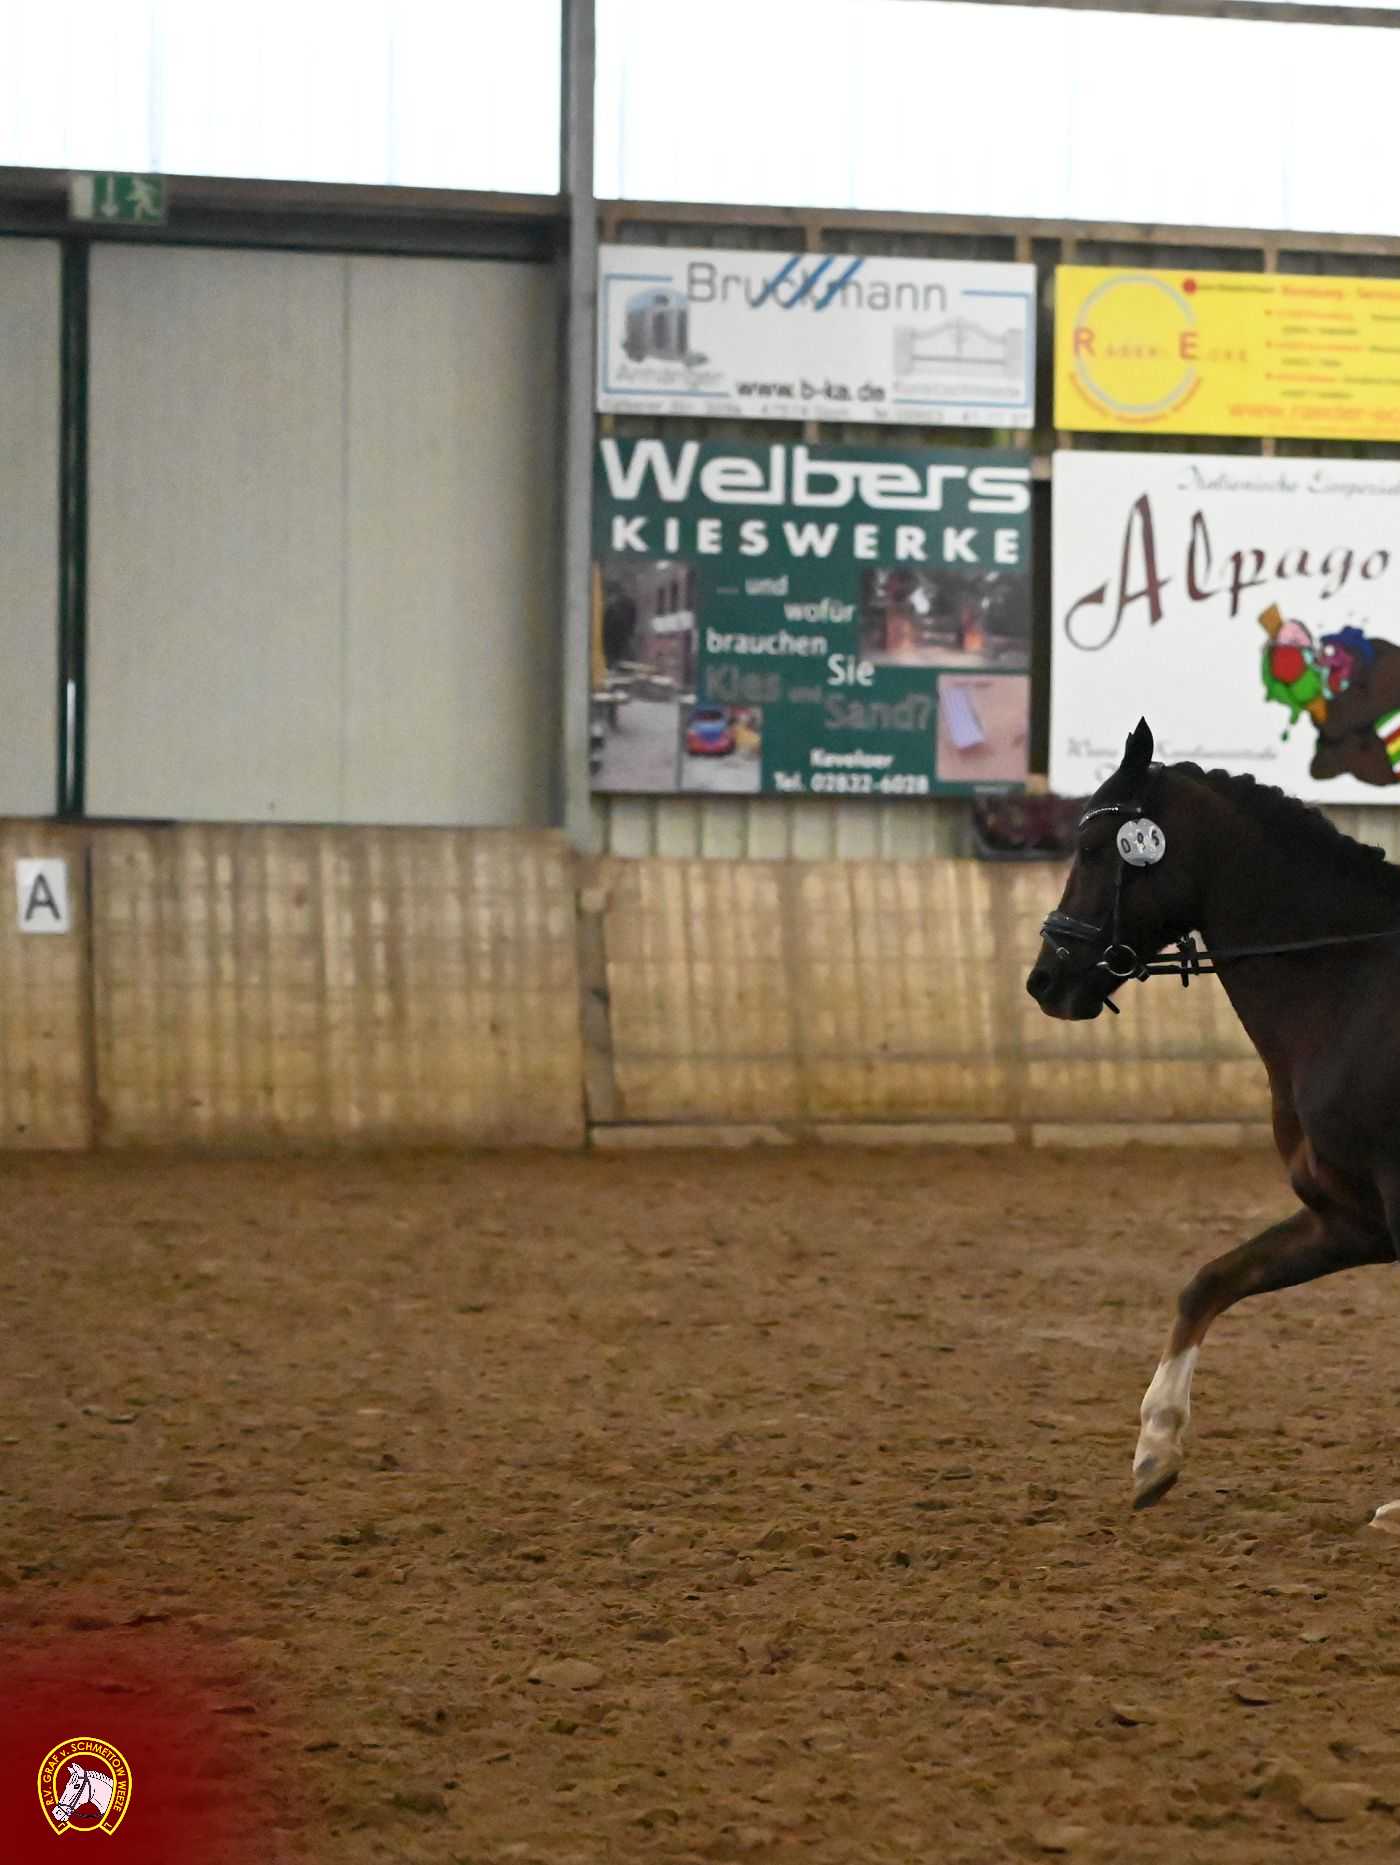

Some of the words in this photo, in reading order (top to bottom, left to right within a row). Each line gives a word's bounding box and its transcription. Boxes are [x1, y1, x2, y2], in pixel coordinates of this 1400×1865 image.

[687, 260, 947, 311] Bruckmann
[600, 437, 1032, 515] Welbers
[611, 515, 1020, 565] KIESWERKE
[744, 574, 790, 597] und
[1064, 493, 1391, 652] Alpago
[783, 597, 857, 624] wofür
[706, 627, 828, 657] brauchen
[827, 652, 876, 688] Sie
[823, 691, 932, 731] Sand?
[25, 872, 61, 921] A
